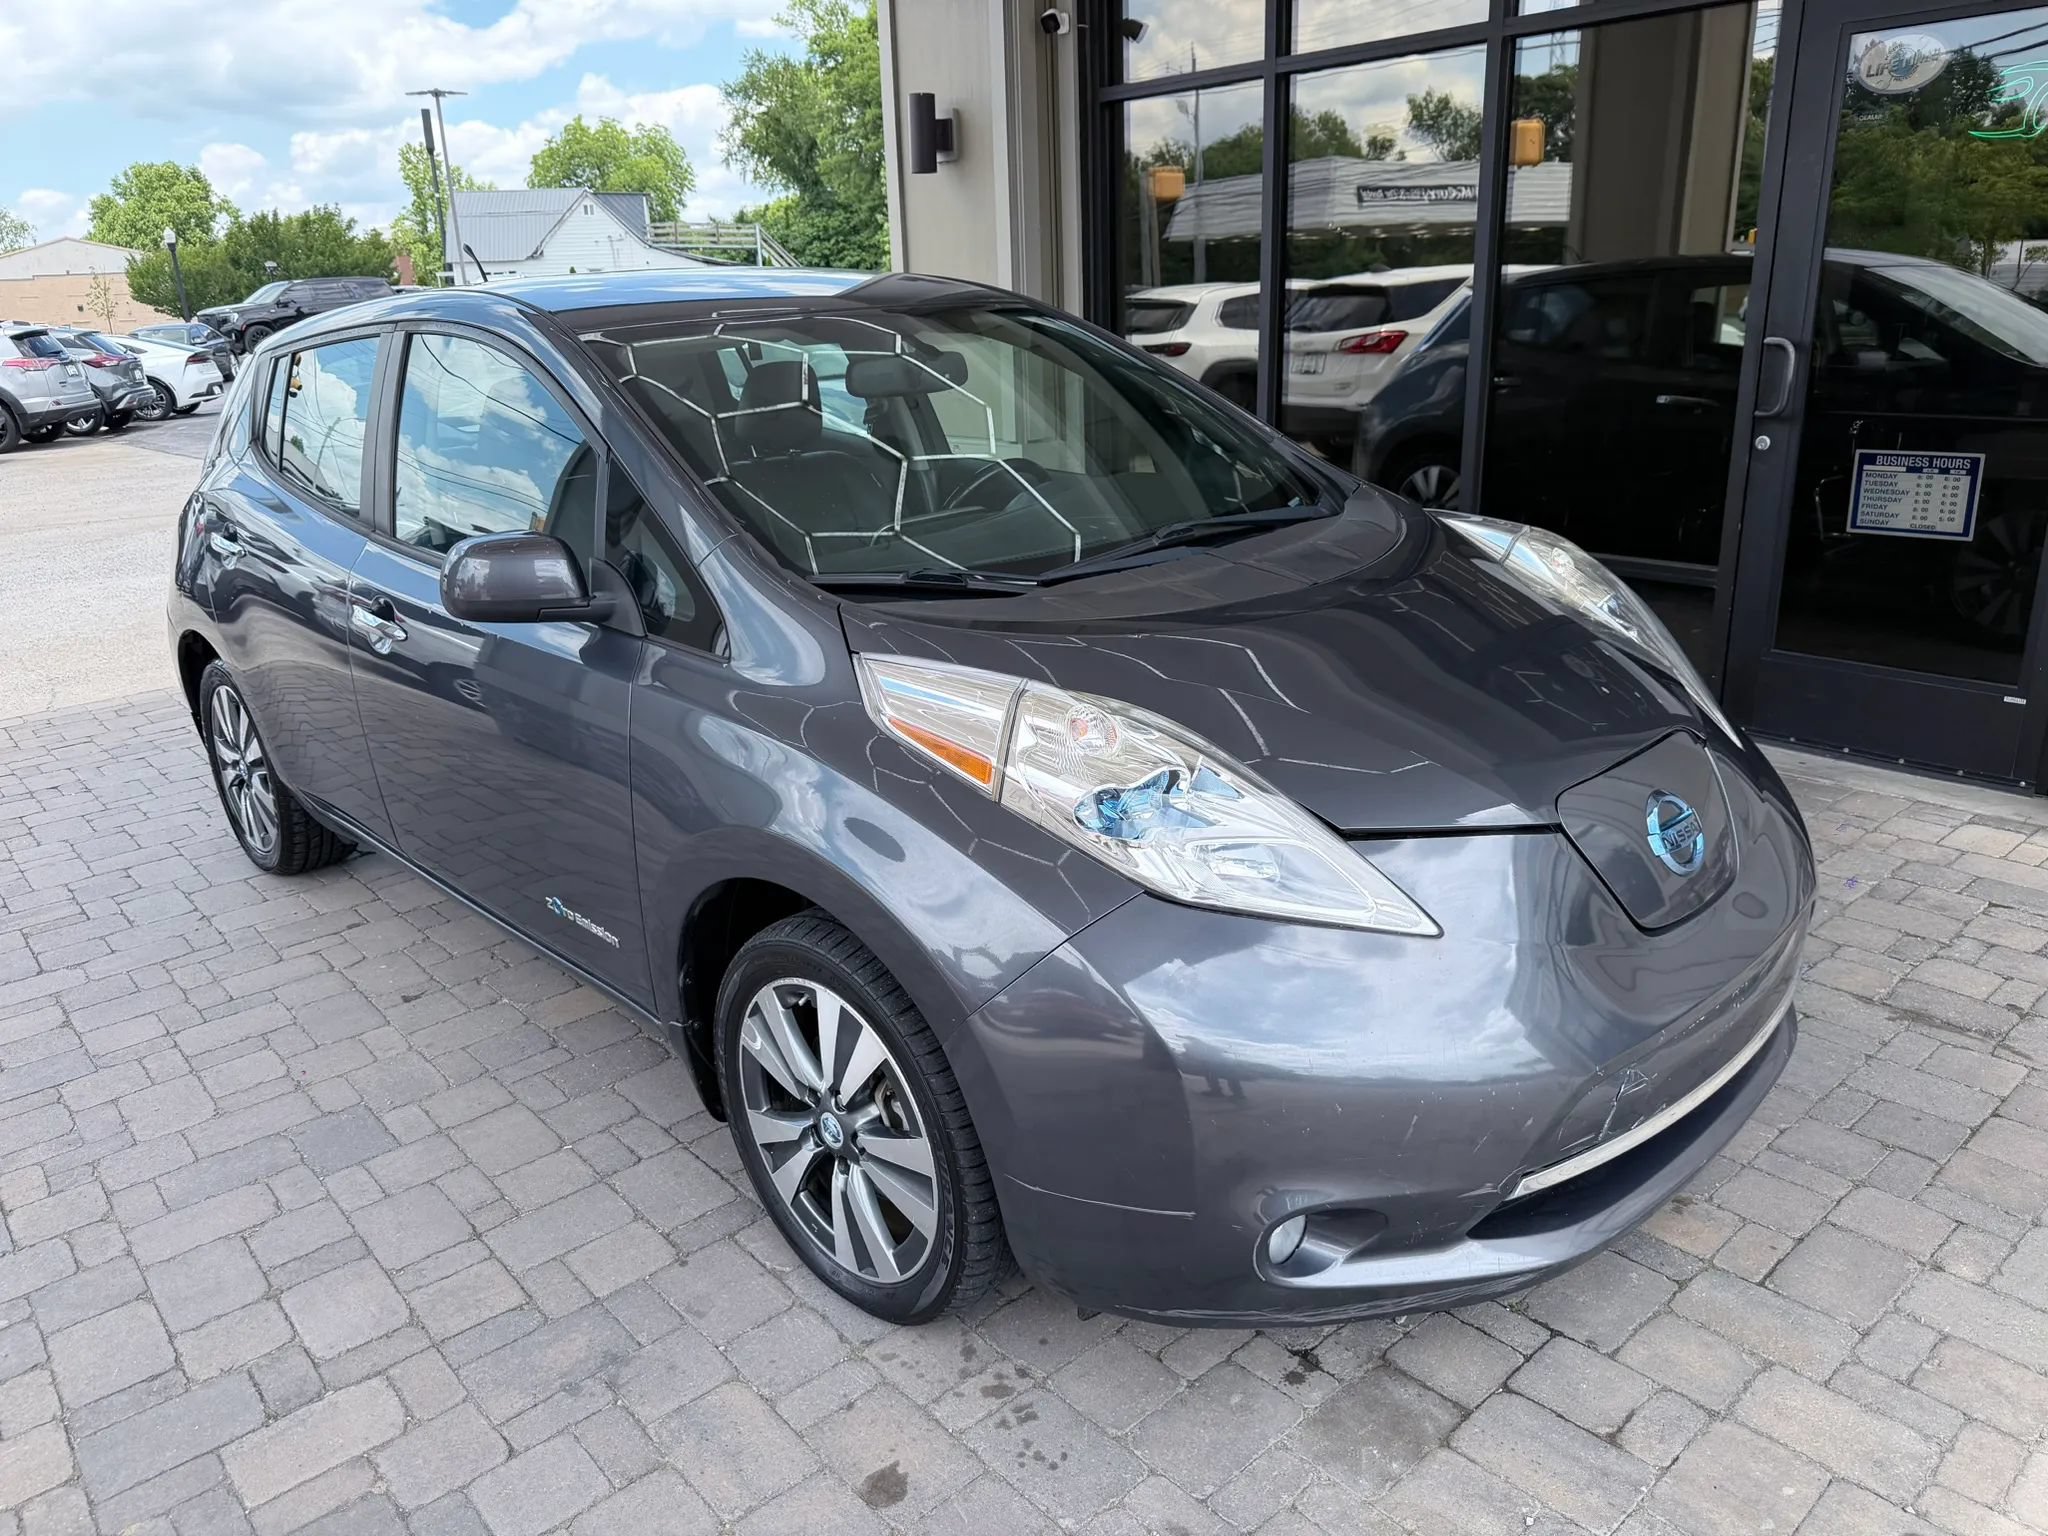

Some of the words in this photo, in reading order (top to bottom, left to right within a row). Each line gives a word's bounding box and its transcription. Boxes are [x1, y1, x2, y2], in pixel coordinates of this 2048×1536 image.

[1876, 455, 1930, 467] BUSINESS
[1932, 457, 1971, 469] HOURS
[1863, 488, 1910, 496] WEDNESDAY
[575, 912, 619, 948] Emission
